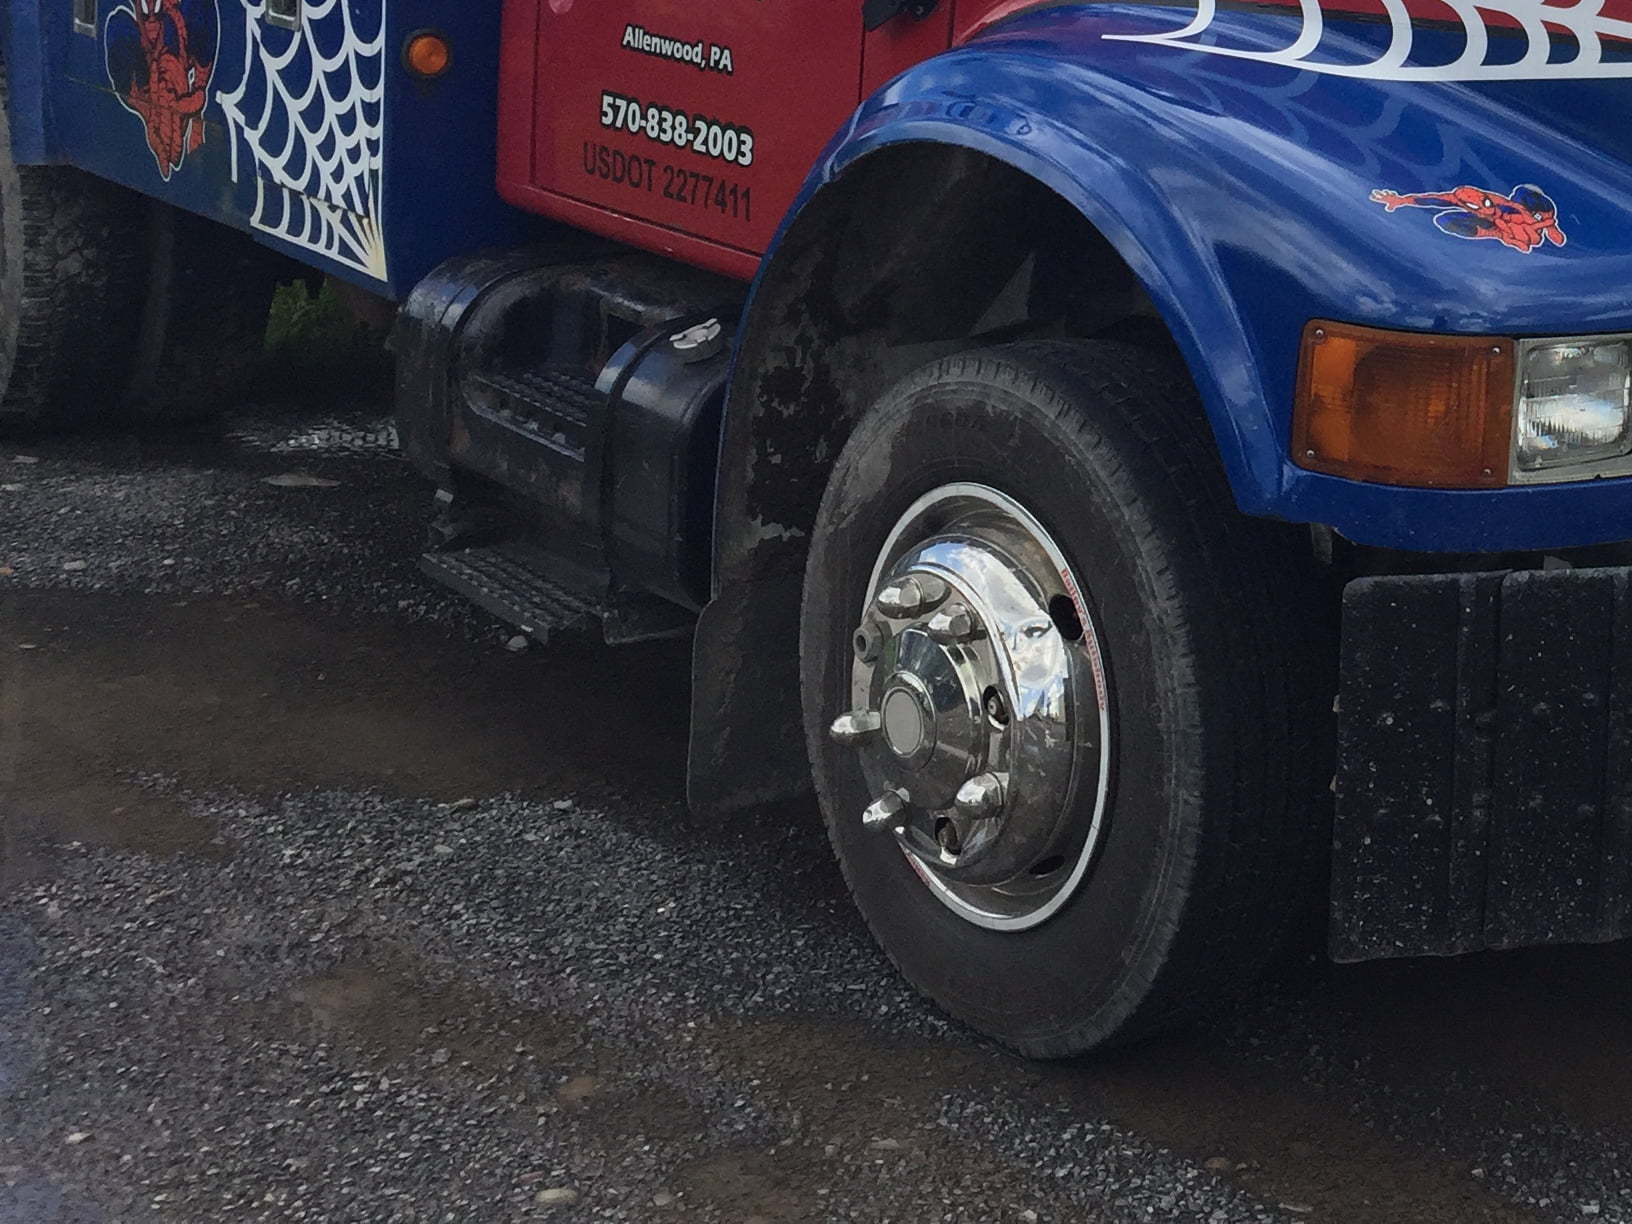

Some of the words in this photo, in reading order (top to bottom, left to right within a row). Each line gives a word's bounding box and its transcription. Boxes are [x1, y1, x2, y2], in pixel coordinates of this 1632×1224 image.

[622, 25, 706, 68] Allenwood,
[709, 45, 733, 73] PA
[600, 94, 754, 166] 570-838-2003
[583, 142, 655, 192] USDOT
[662, 164, 751, 221] 2277411
